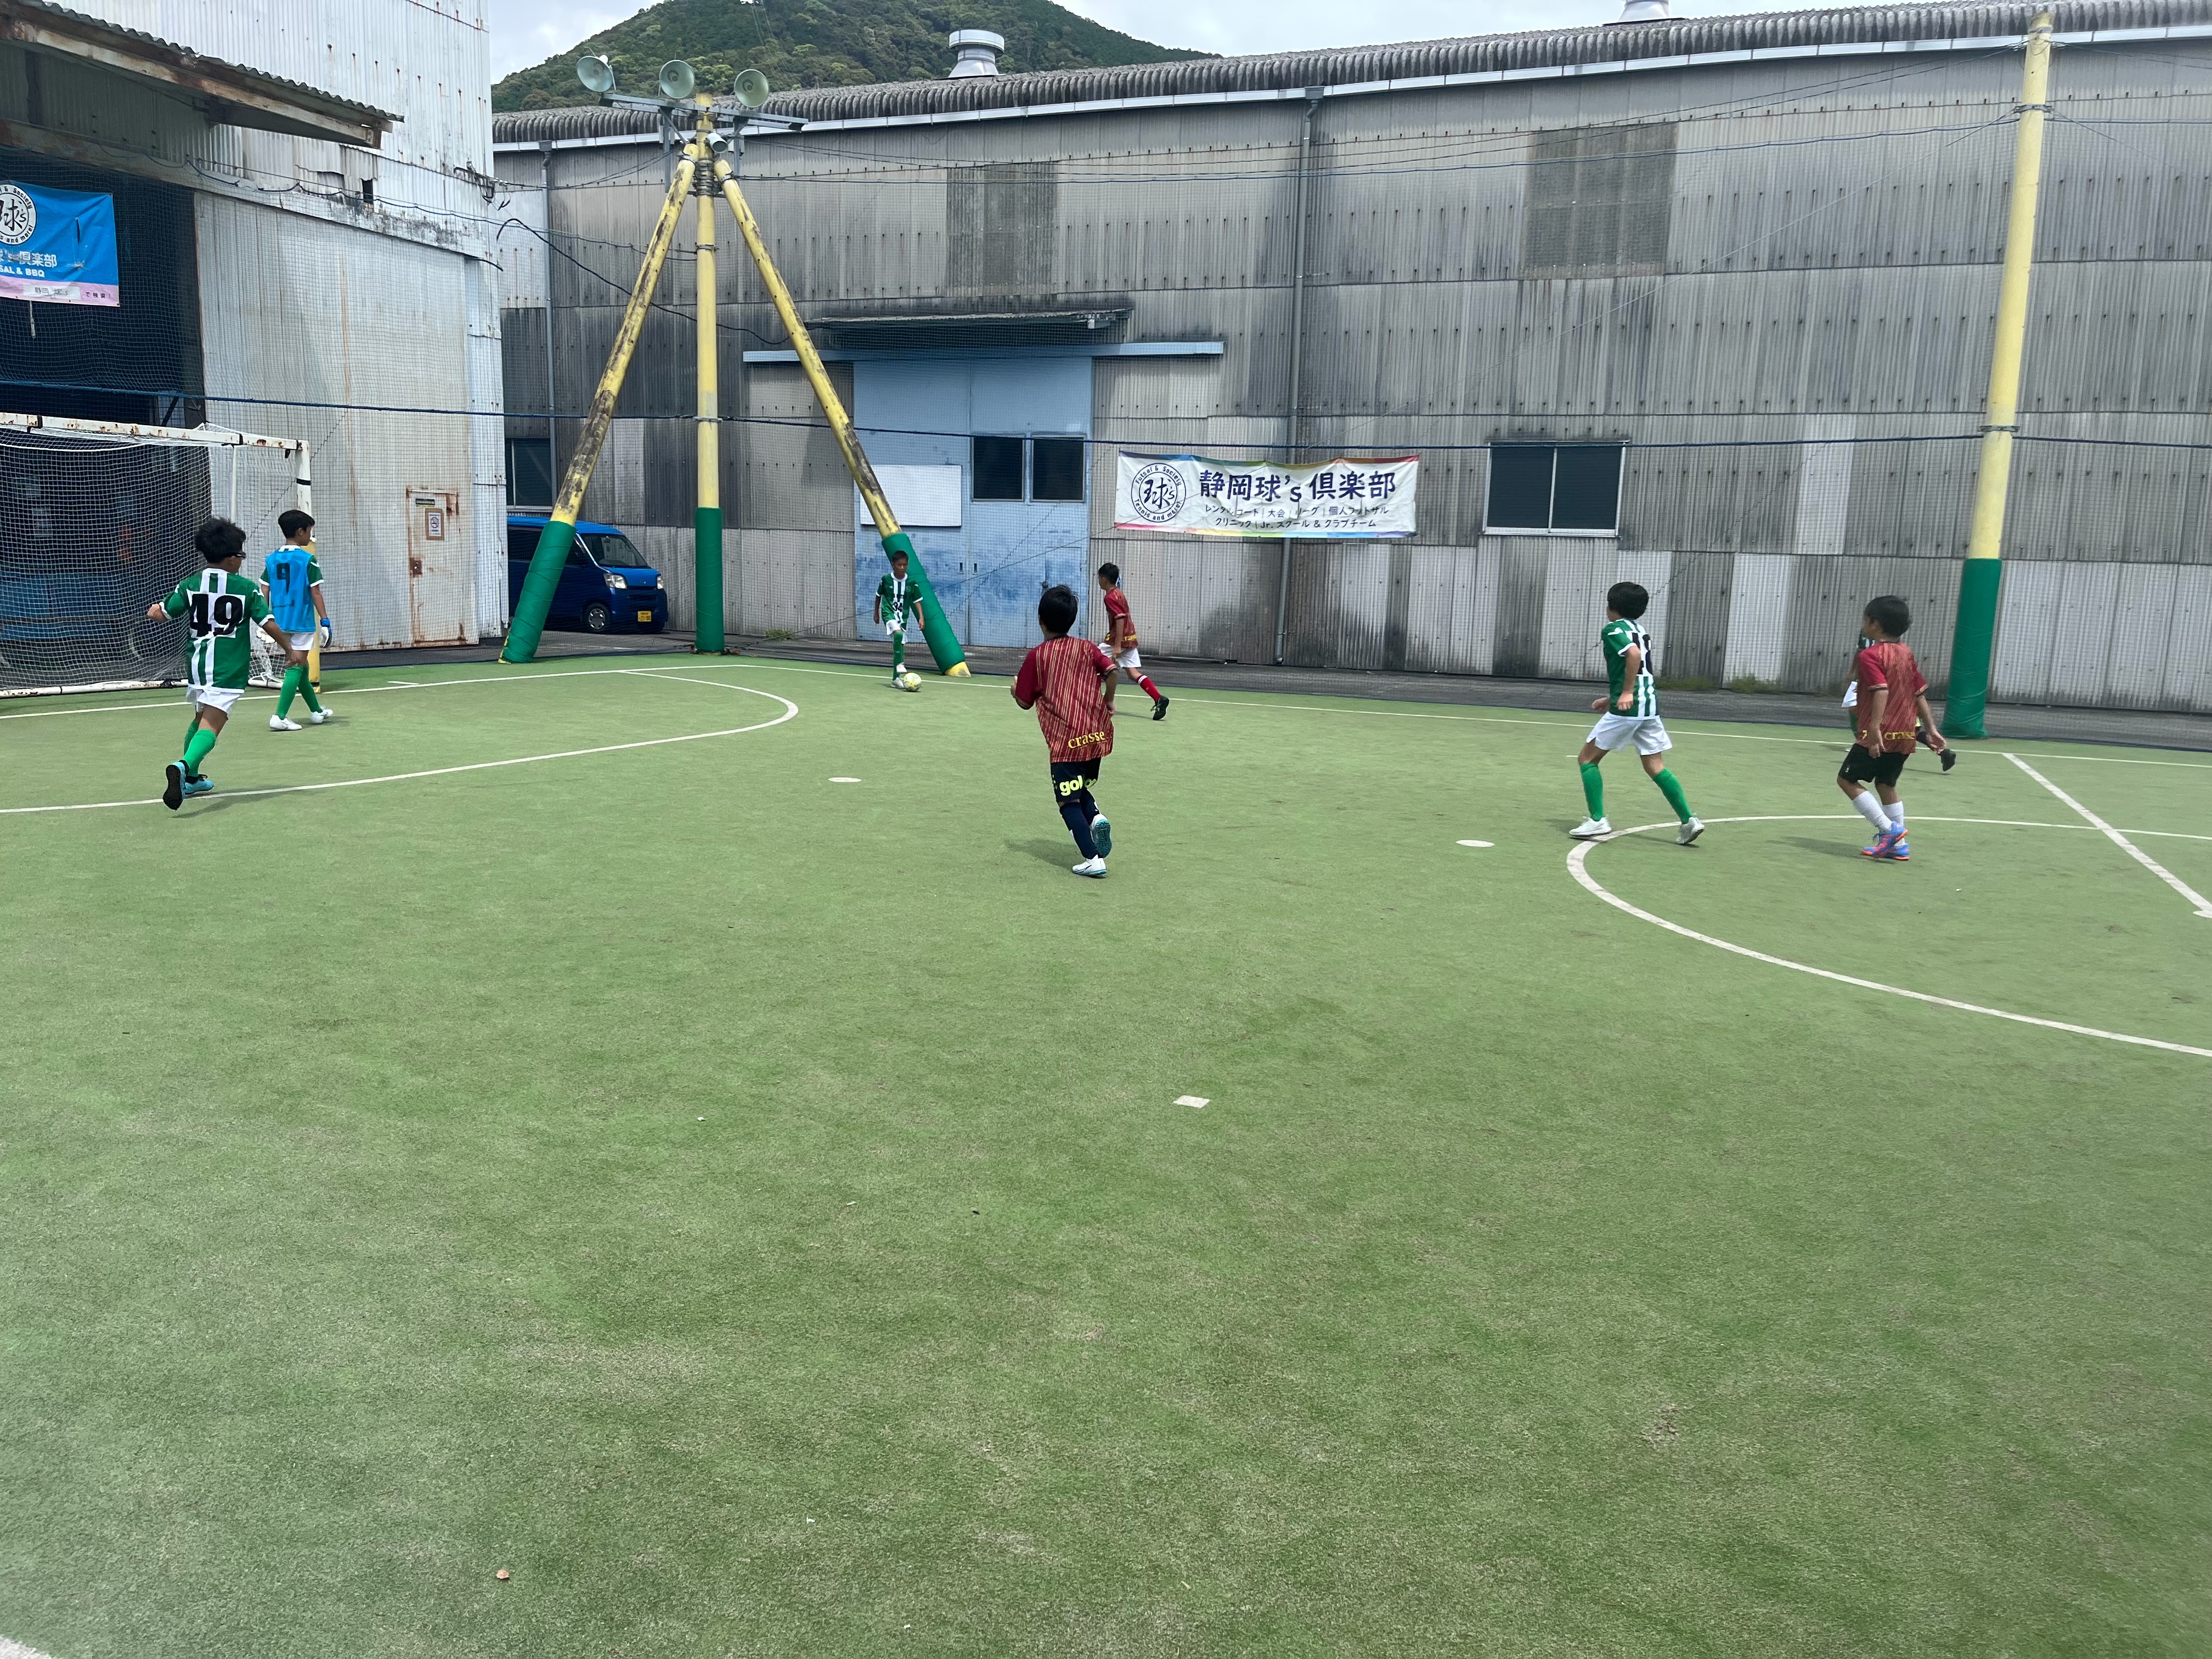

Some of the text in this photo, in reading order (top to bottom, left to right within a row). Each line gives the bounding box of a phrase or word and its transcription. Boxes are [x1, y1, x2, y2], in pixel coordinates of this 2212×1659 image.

[25, 268, 45, 278] BBQ
[1135, 466, 1153, 484] Futsal
[1163, 466, 1182, 487] Society
[1135, 499, 1151, 518] Tennis
[1268, 509, 1285, 518] 大会
[1215, 517, 1251, 528] クリニック
[1277, 520, 1310, 528] スクール
[1324, 519, 1376, 528] クラブチーム
[276, 562, 290, 594] 9
[190, 594, 243, 637] 49
[1068, 731, 1106, 749] crasse
